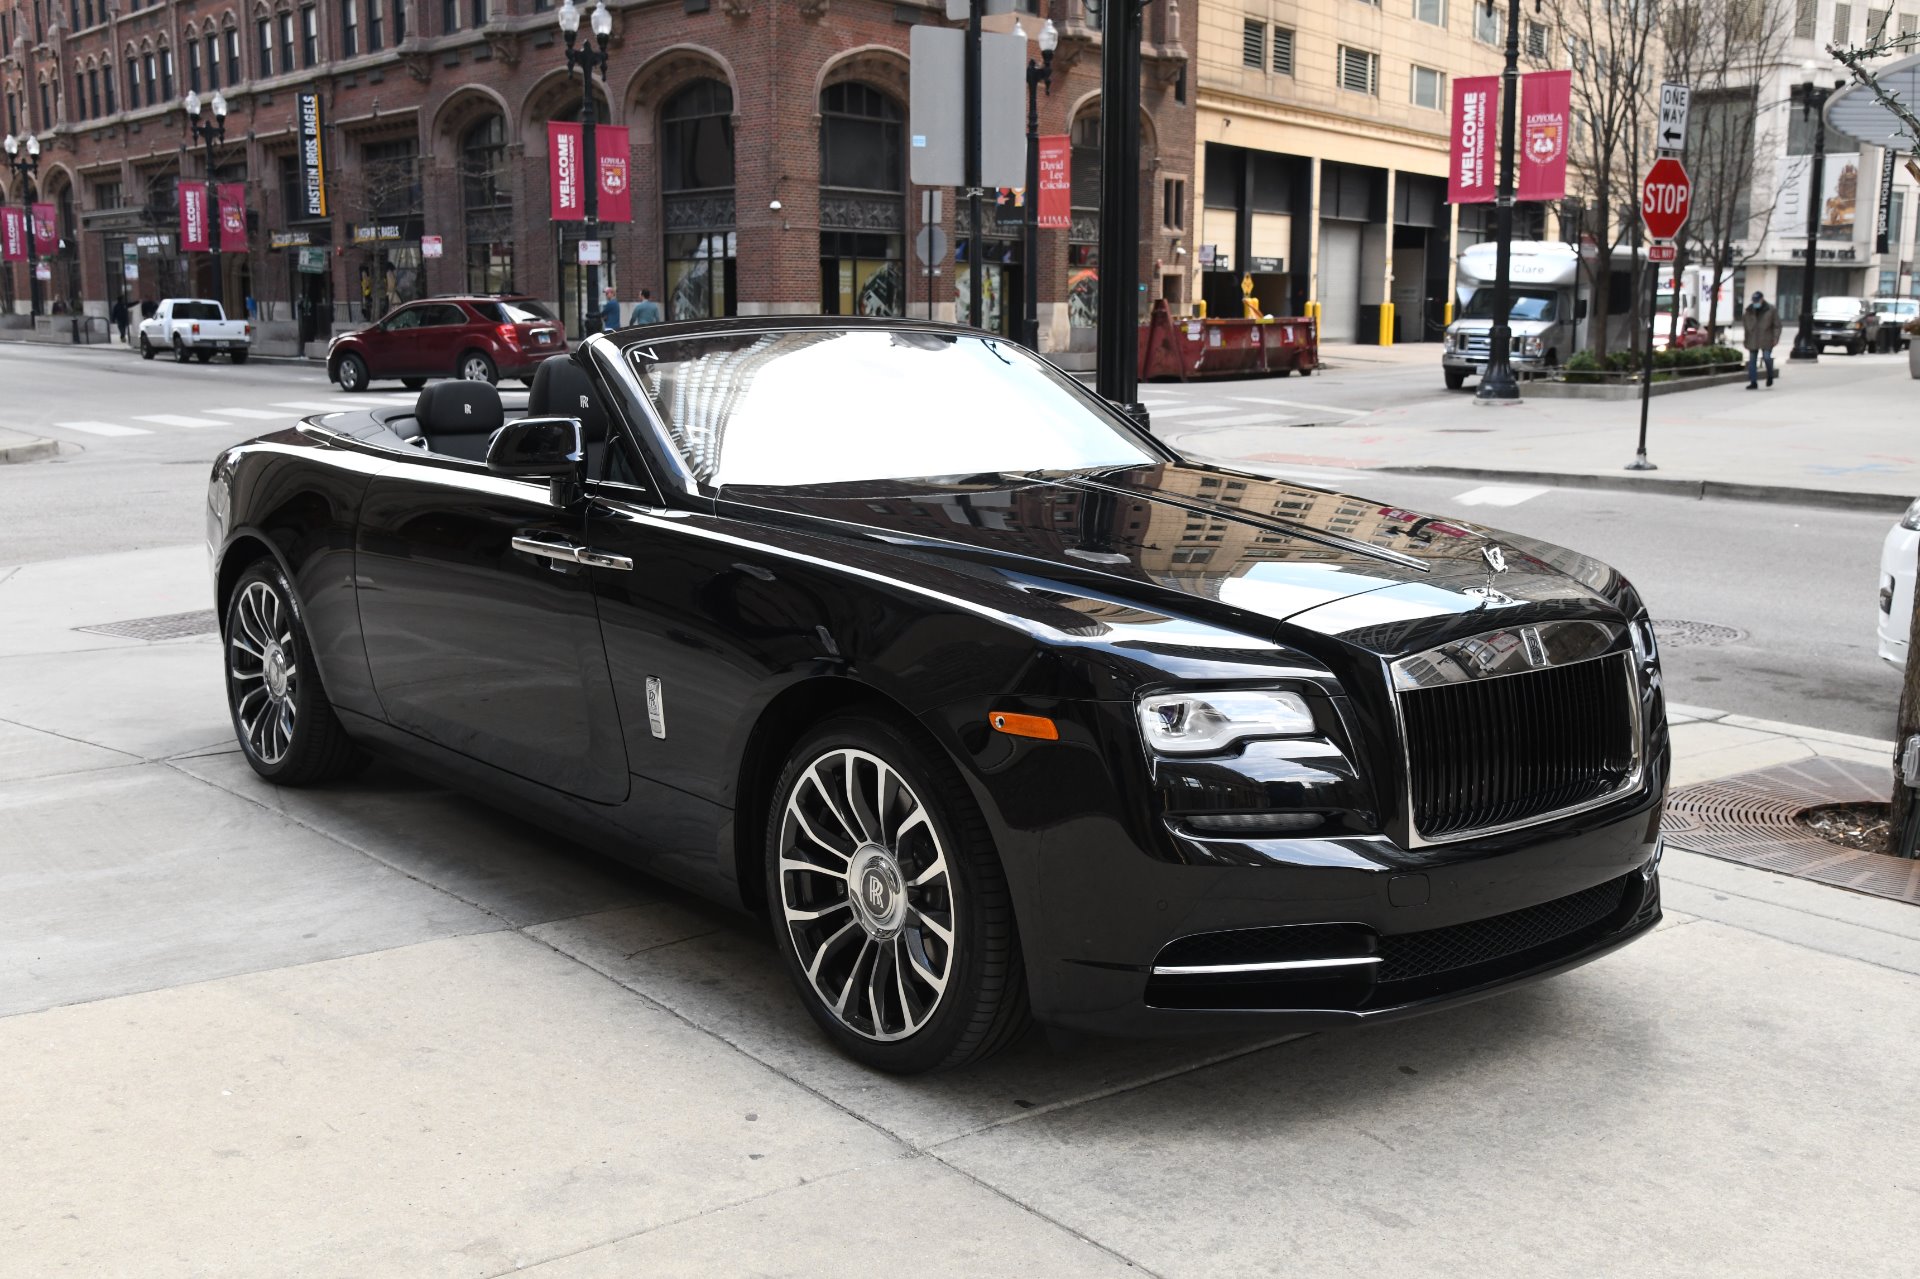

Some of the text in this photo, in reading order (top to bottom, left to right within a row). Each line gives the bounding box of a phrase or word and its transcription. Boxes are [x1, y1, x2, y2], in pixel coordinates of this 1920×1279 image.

[1478, 92, 1486, 127] CAMPUS
[1664, 89, 1687, 107] ONE
[303, 95, 317, 135] BAGELS
[1527, 114, 1562, 123] LOYOLA
[1662, 108, 1686, 124] WAY
[1460, 91, 1478, 189] WELCOME
[1477, 129, 1485, 158] TOWER
[558, 134, 570, 208] WELCOME
[600, 157, 626, 166] LOYOLA
[308, 168, 321, 215] EINSTEIN
[1880, 148, 1894, 206] ORDSTROM
[1644, 183, 1688, 215] STOP
[185, 191, 197, 243] WELCOME
[1037, 215, 1071, 226] LUMA
[1651, 247, 1674, 258] ALL WAY
[1513, 263, 1545, 274] Clare
